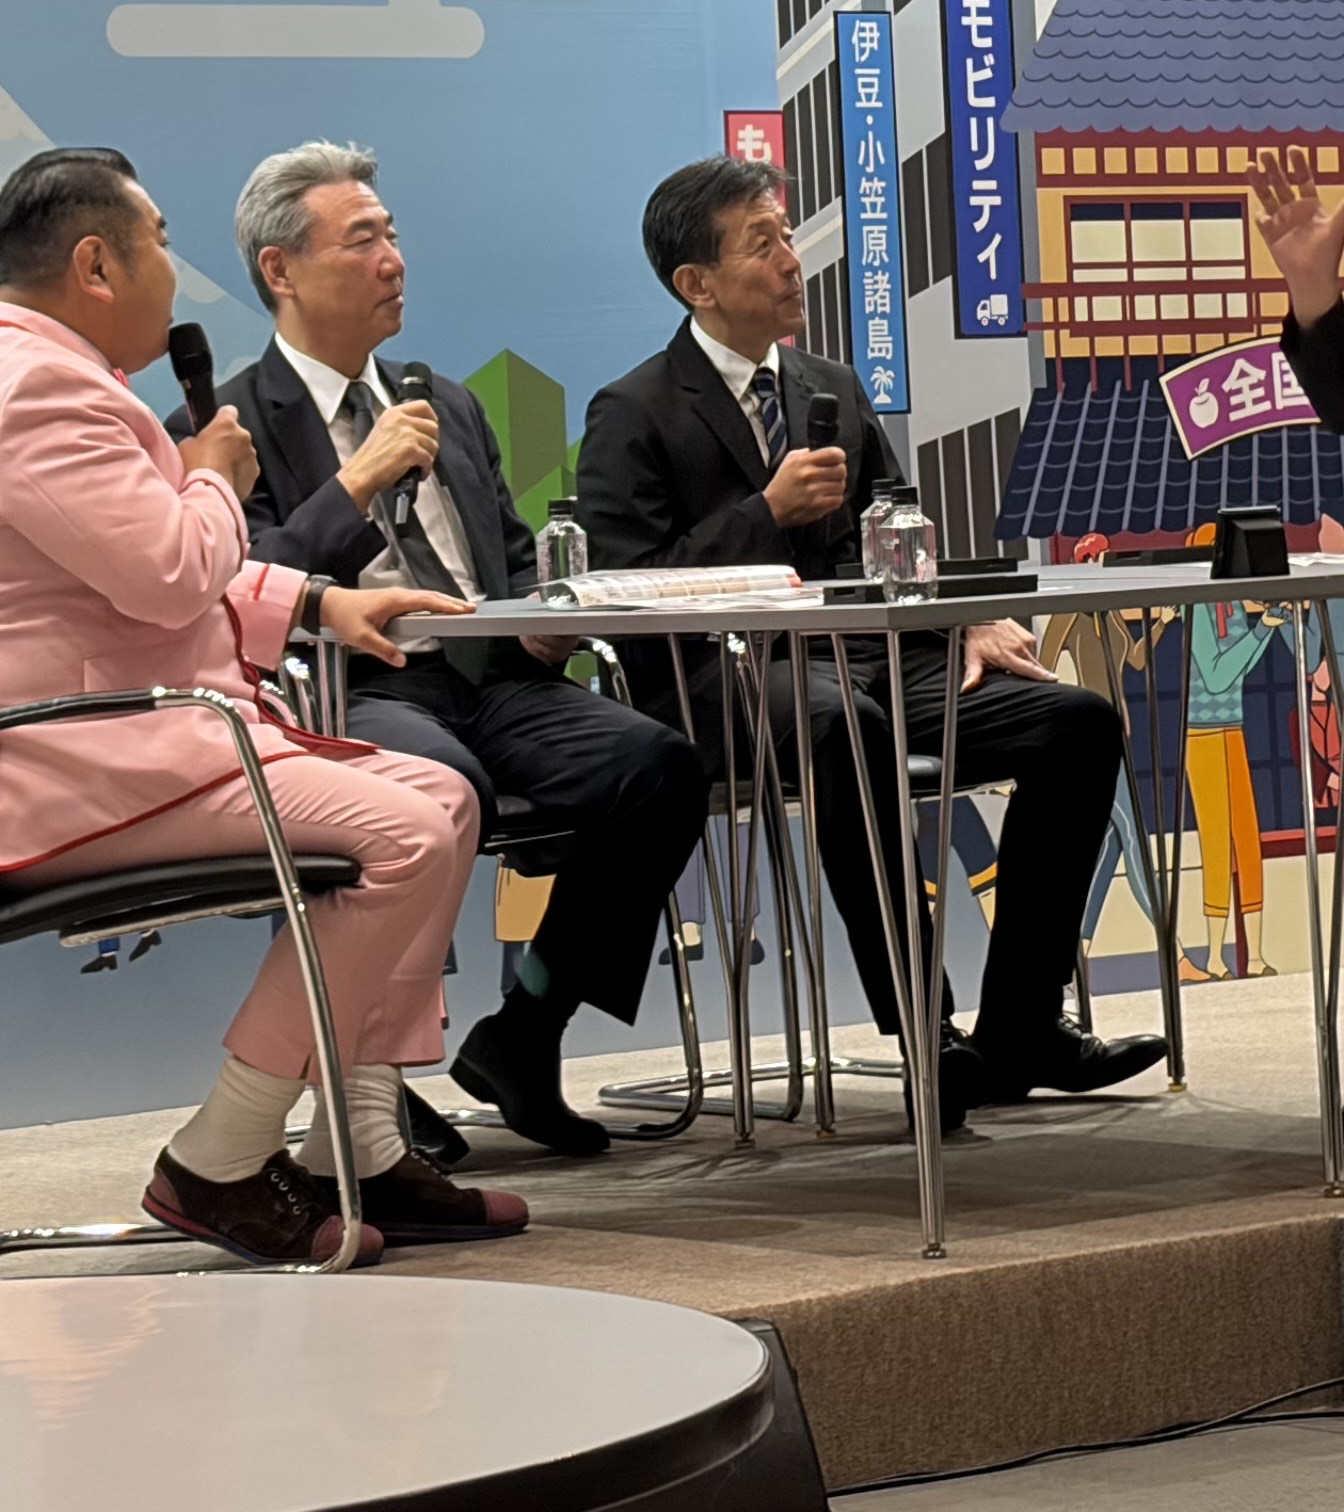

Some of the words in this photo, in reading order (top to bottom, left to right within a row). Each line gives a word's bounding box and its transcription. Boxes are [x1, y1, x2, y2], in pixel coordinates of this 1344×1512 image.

[852, 20, 893, 360] 伊豆・小笠原諸島
